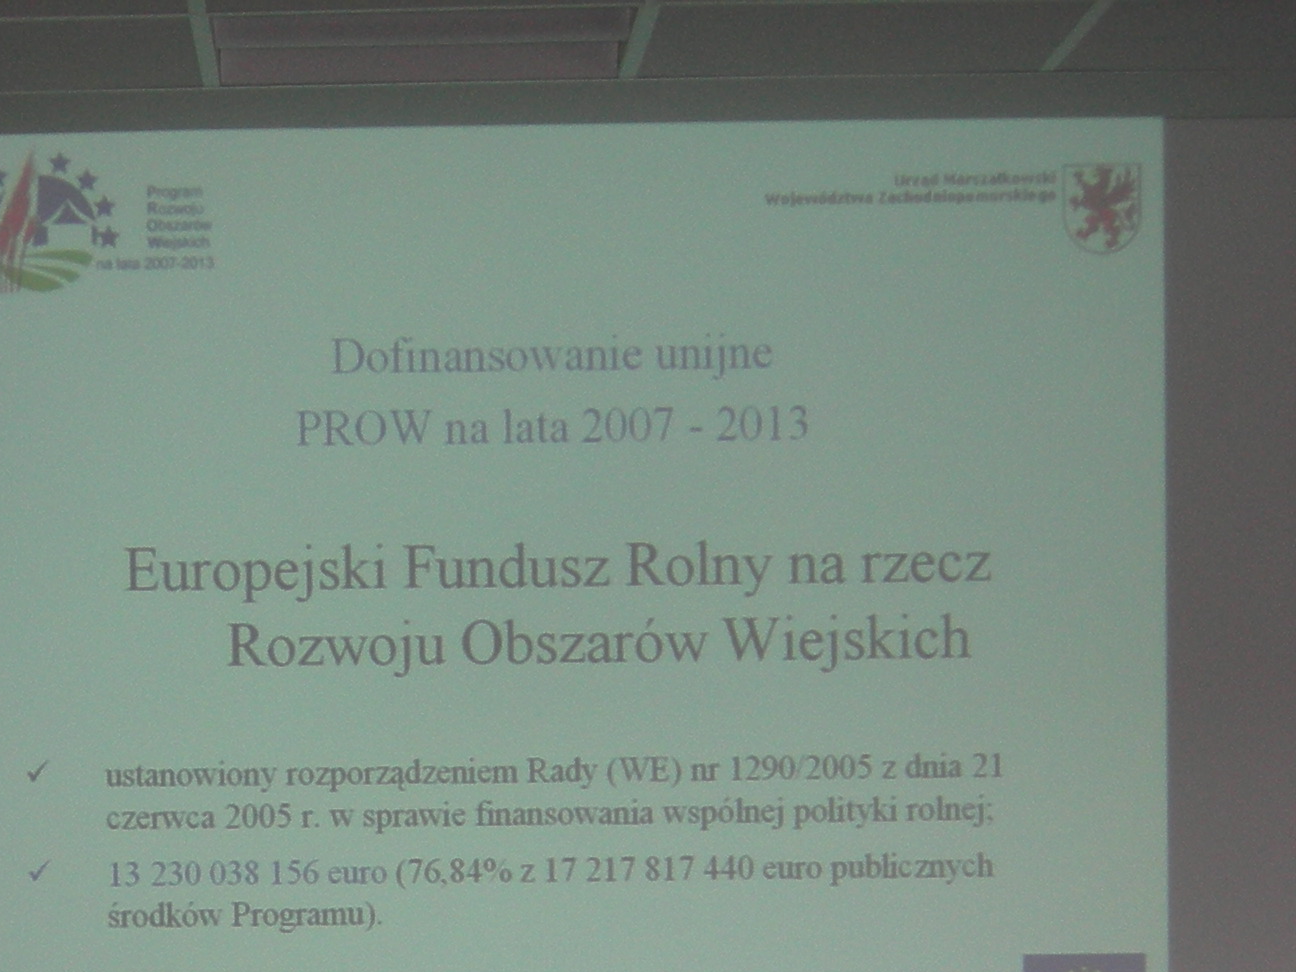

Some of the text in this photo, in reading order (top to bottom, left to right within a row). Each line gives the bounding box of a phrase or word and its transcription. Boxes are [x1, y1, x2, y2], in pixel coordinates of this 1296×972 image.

[332, 333, 772, 380] Dofinansowanie unijne
[297, 409, 432, 446] PROW
[445, 420, 489, 445] na
[504, 408, 569, 444] lata
[582, 406, 674, 443] 2007
[717, 405, 808, 442] 2013
[125, 540, 991, 603] Europejski Fundusz Rolny na rzecz
[228, 613, 971, 677] Rozwoju Obszarów Wiejskich
[105, 752, 1002, 793] ustanowiony rozporządzeniem Rady (WE) nr 1290/2005 z dnia 21
[106, 794, 993, 834] czerwca 2005 r. w sprawie finansowania wspólnej polityki rolnej;
[111, 852, 994, 889] 13 230 038 156 euro (76,84% z 17 217 817 440 euro publicznych
[108, 902, 382, 933] środków Programu).
